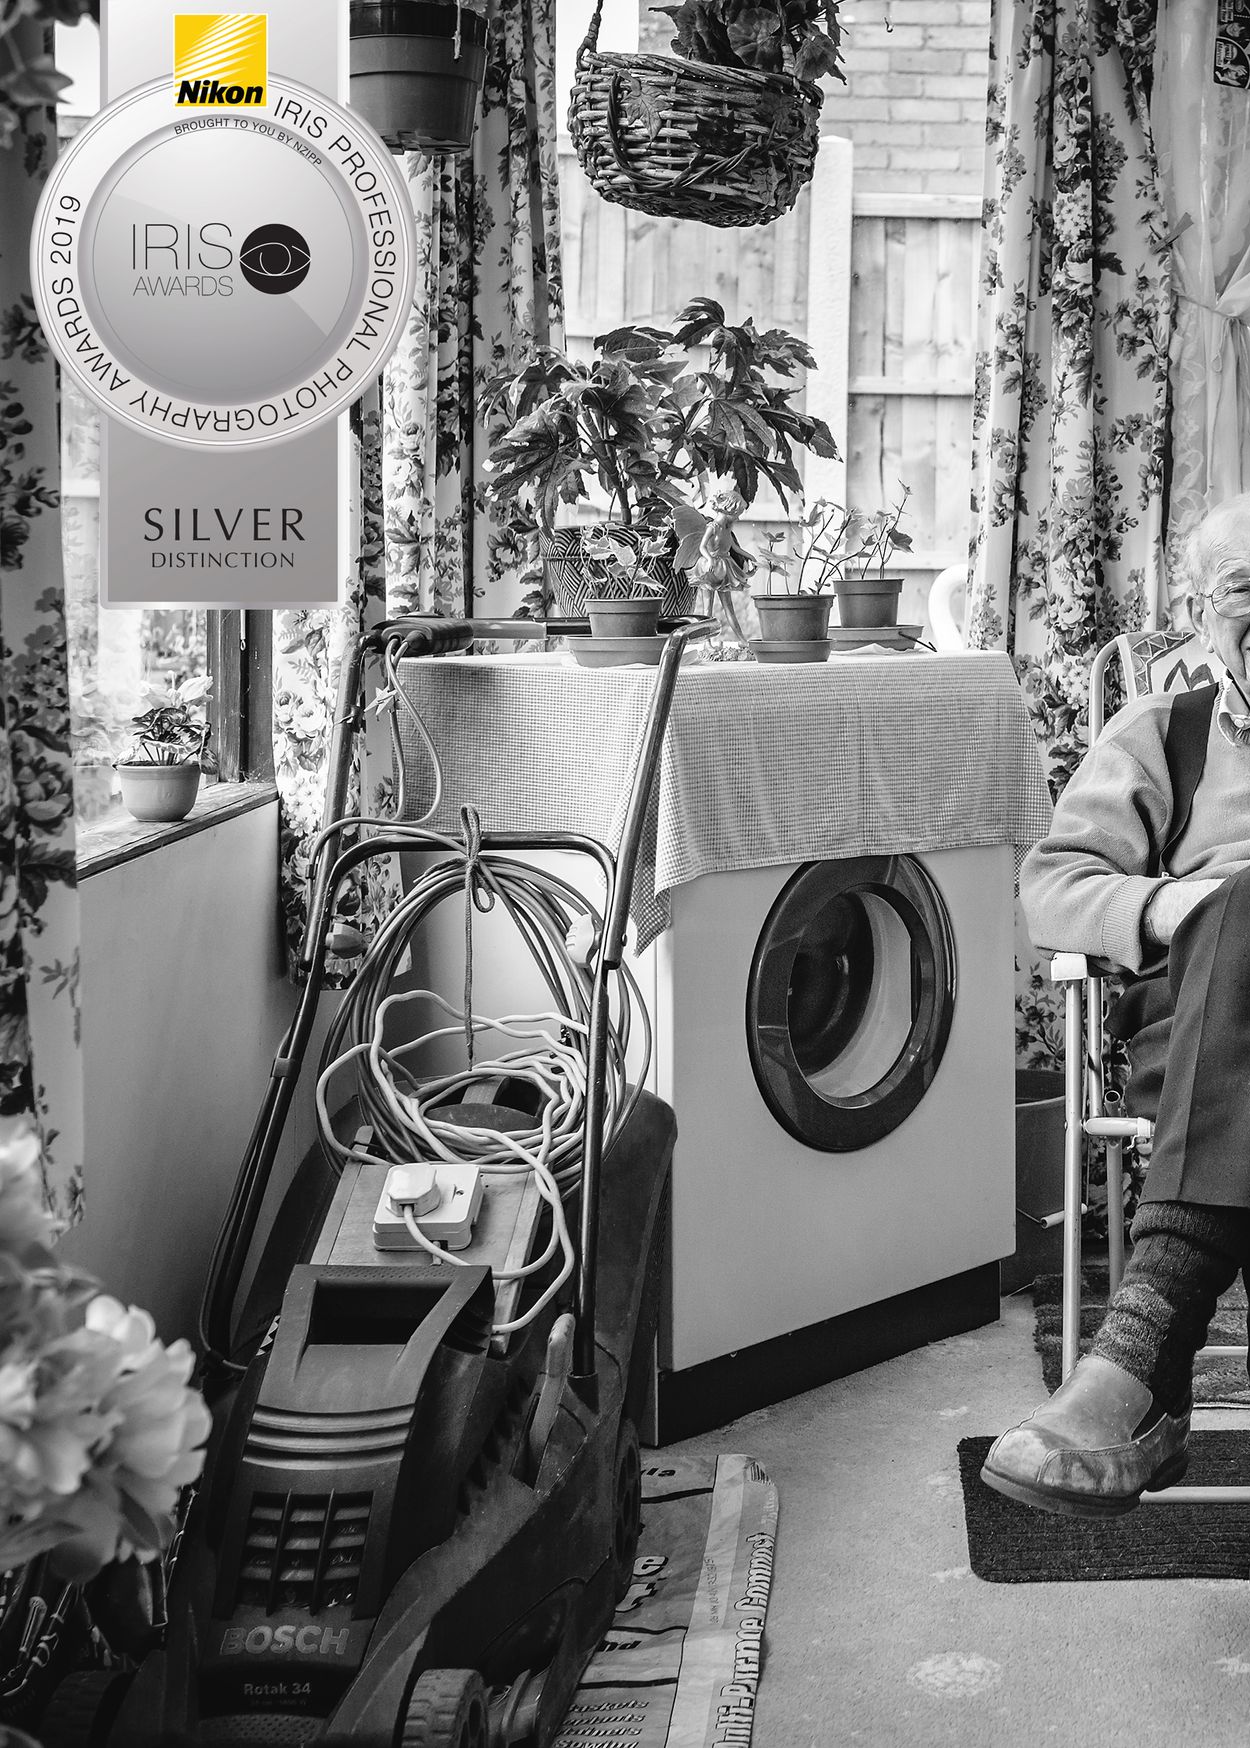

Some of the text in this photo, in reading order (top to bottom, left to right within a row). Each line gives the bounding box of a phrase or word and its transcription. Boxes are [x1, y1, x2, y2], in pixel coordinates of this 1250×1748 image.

[220, 1624, 350, 1656] BOSCH
[243, 1682, 311, 1696] Rotak 34
